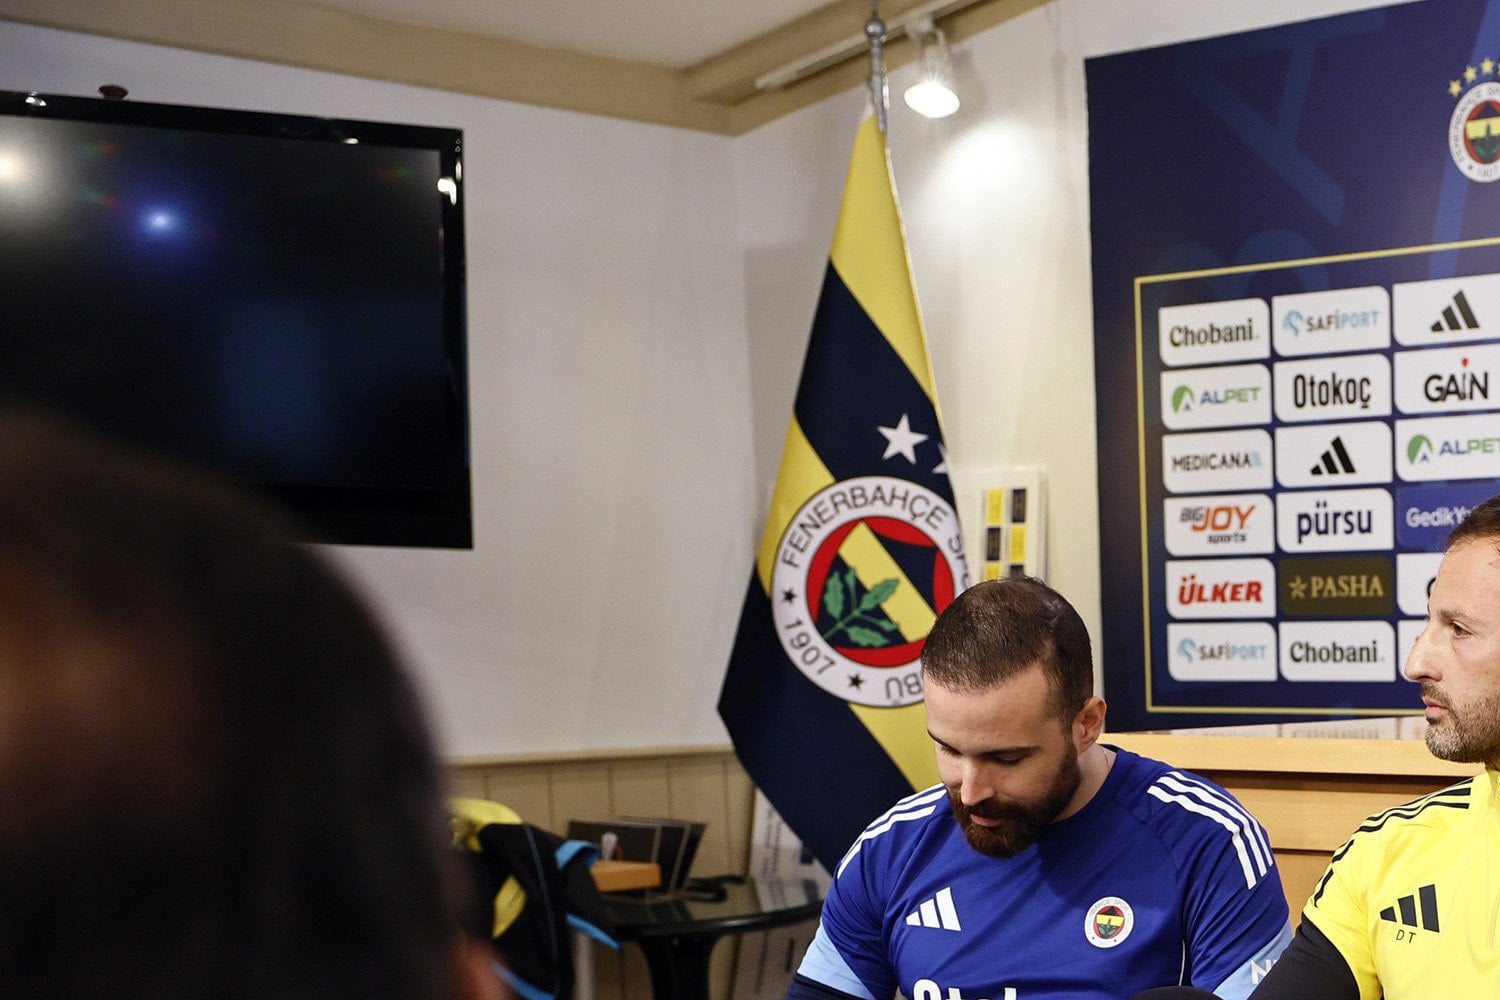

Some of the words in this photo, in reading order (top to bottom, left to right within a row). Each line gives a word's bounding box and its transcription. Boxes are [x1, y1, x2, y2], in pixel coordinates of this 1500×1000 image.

[1170, 319, 1253, 347] Chobani
[1201, 387, 1260, 405] ALPET
[1294, 373, 1371, 409] Otokoç
[1173, 454, 1252, 471] MEDICANA
[781, 485, 948, 569] FENERBAHÇE
[1191, 505, 1256, 532] JOY
[1297, 501, 1372, 544] pürsu
[1178, 574, 1263, 606] ÜLKER
[1311, 574, 1384, 599] PASHA
[785, 620, 835, 674] 1907
[1290, 639, 1377, 664] Chobani
